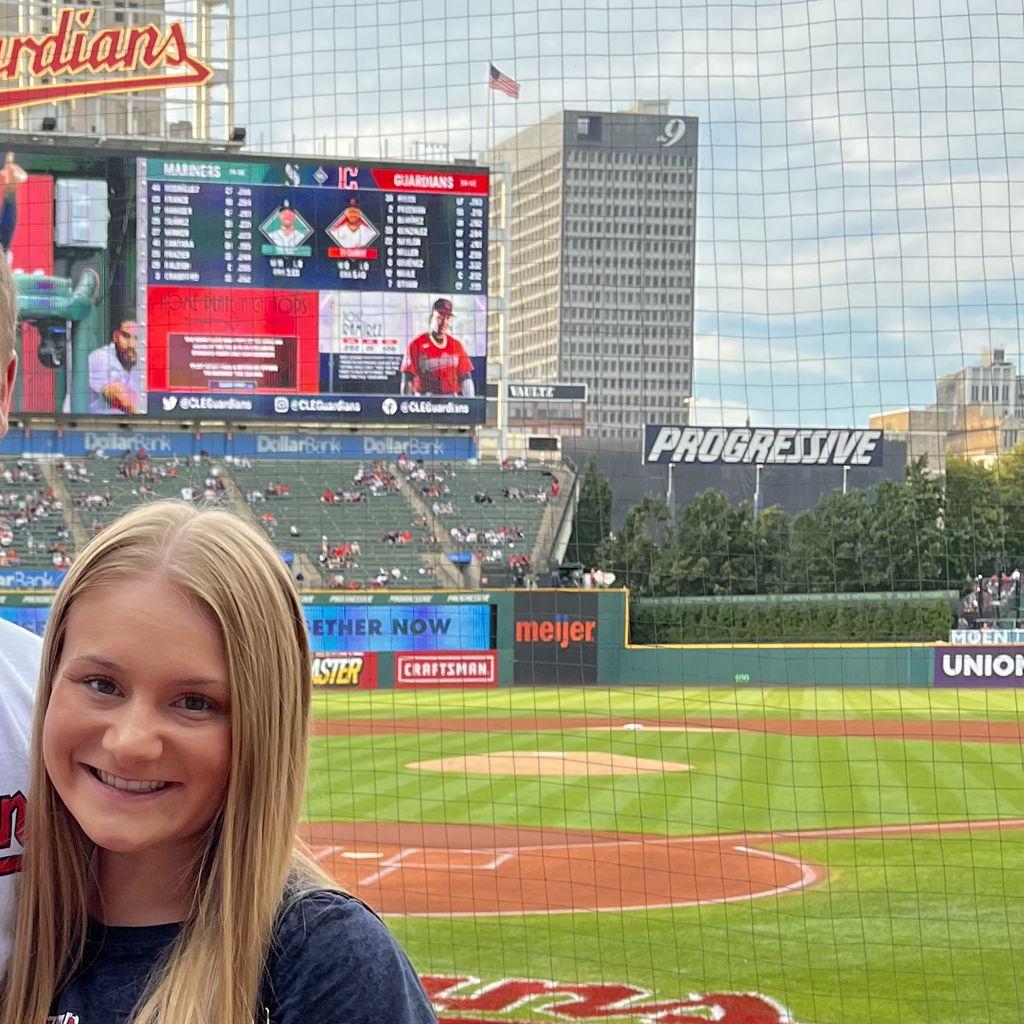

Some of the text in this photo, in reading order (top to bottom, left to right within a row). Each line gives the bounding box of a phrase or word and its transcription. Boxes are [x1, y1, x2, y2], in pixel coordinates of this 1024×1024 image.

[163, 163, 222, 178] MARINERS
[393, 173, 455, 190] GUARDIANS
[179, 397, 253, 412] @CLEGuardians
[289, 399, 362, 413] @CLEGuardians
[399, 401, 470, 416] @CLEGuardians
[84, 432, 172, 451] DollarBank
[257, 434, 344, 454] DollarBank
[363, 436, 445, 455] DollarBank
[648, 426, 882, 465] PROGRESSIVE
[307, 618, 452, 637] ETHER NOW
[516, 613, 596, 648] meijer
[951, 629, 1008, 644] MOEN
[404, 662, 488, 676] CRAFTSMAN
